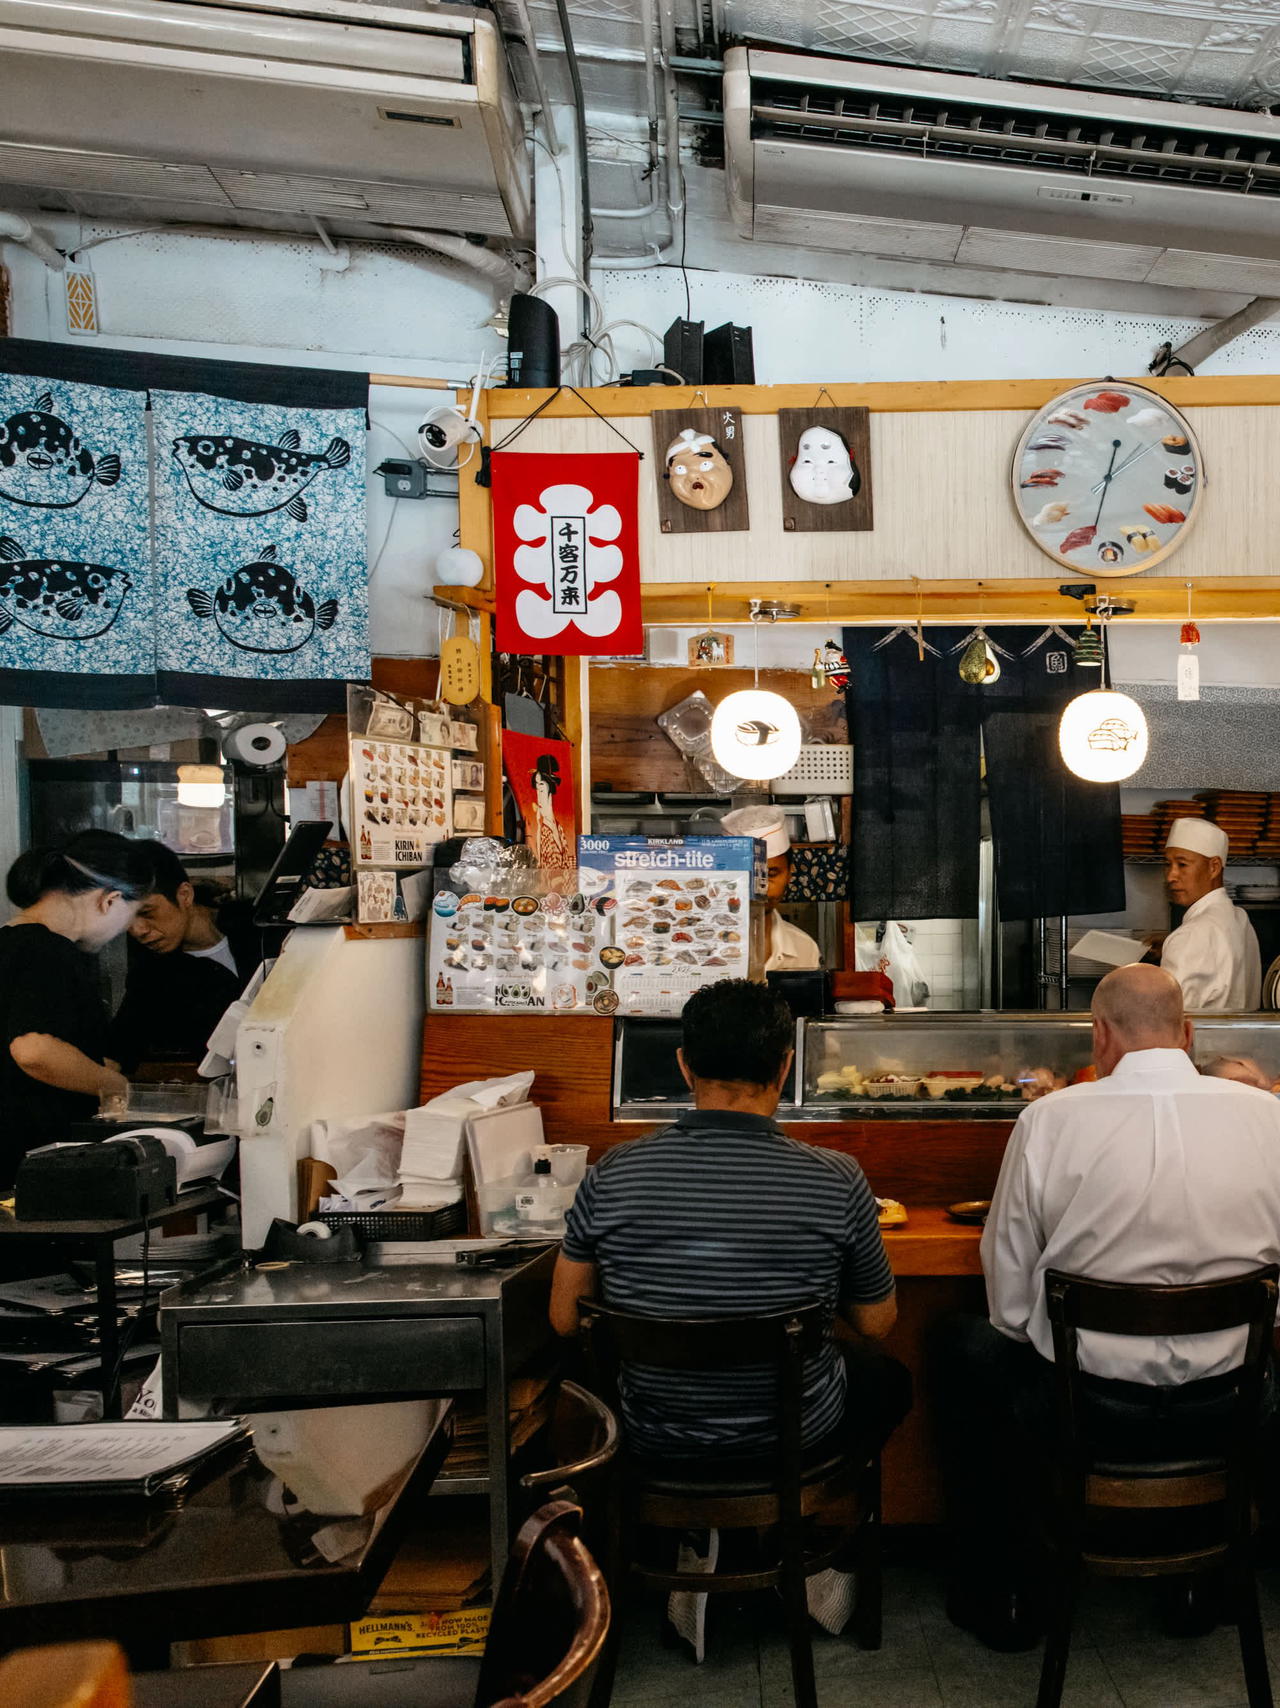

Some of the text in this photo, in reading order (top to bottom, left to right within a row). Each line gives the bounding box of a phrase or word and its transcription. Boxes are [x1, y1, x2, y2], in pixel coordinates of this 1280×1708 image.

[558, 522, 580, 606] 千客万来
[395, 840, 414, 851] KIRIN
[580, 839, 610, 851] 3000
[395, 851, 423, 862] ICHIBAN
[614, 850, 714, 868] stretch-tite
[359, 1621, 414, 1635] HELLMANN'S
